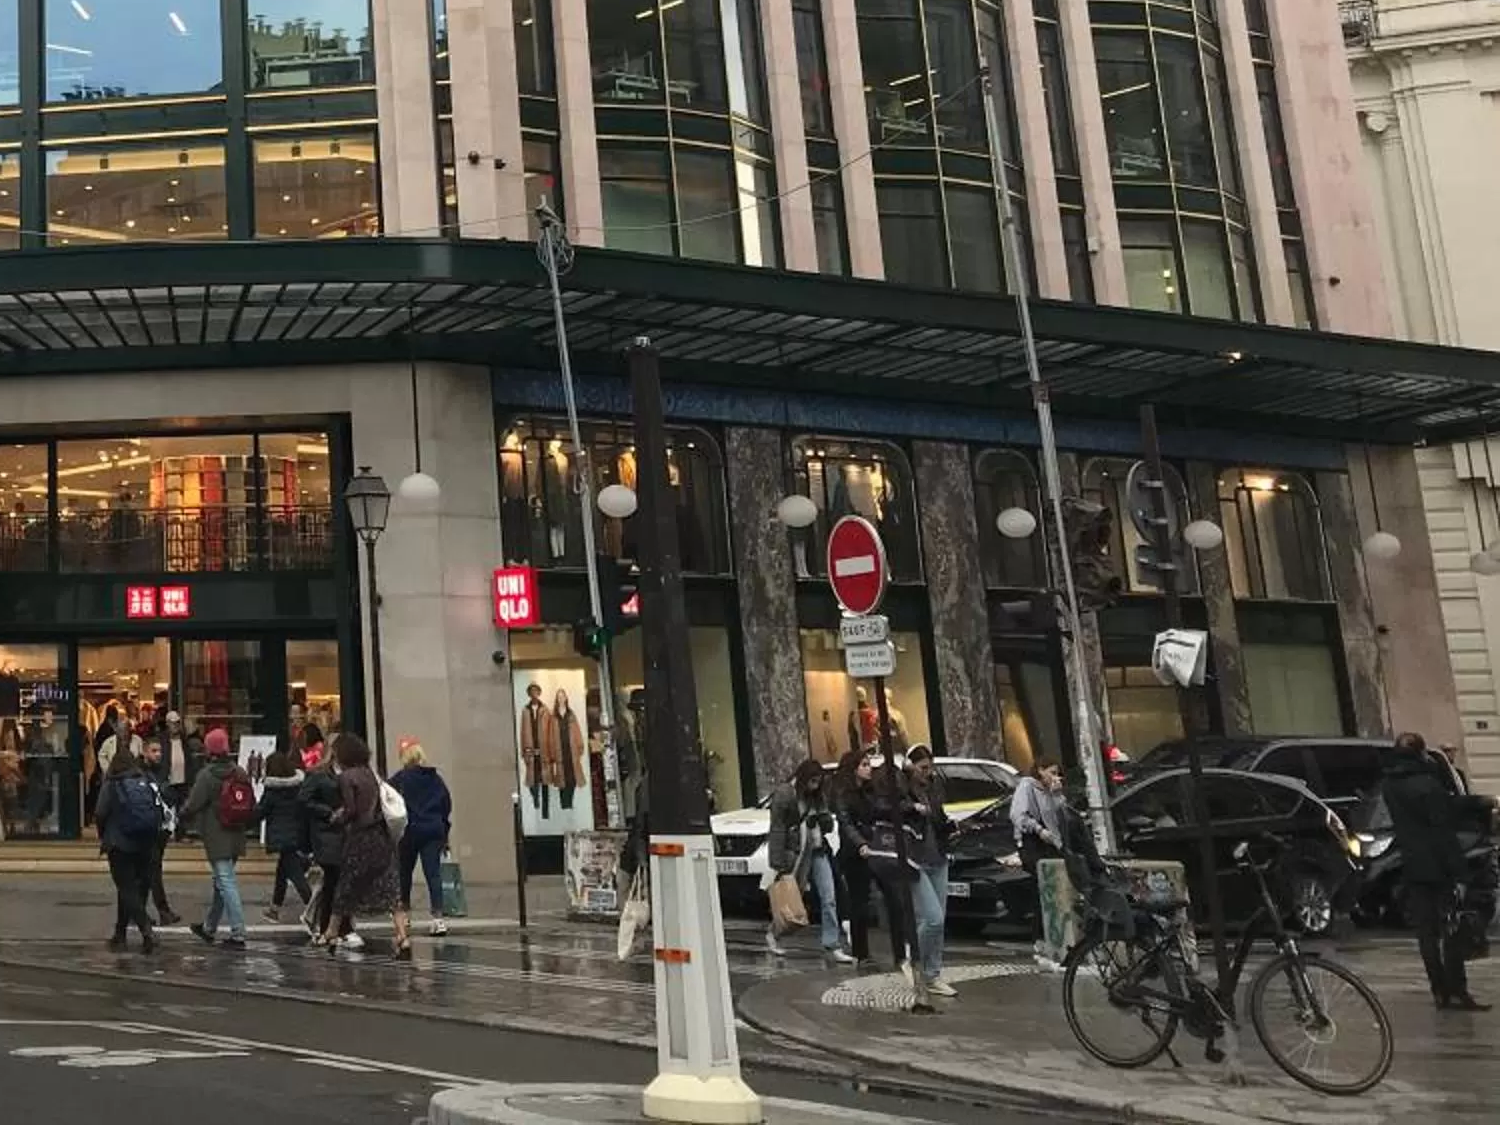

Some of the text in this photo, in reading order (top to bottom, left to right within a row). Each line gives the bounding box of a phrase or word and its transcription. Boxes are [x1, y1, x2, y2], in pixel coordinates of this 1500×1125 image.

[497, 575, 525, 595] UNI
[163, 590, 184, 601] UNI
[163, 602, 187, 615] QLO
[500, 598, 529, 623] QLO
